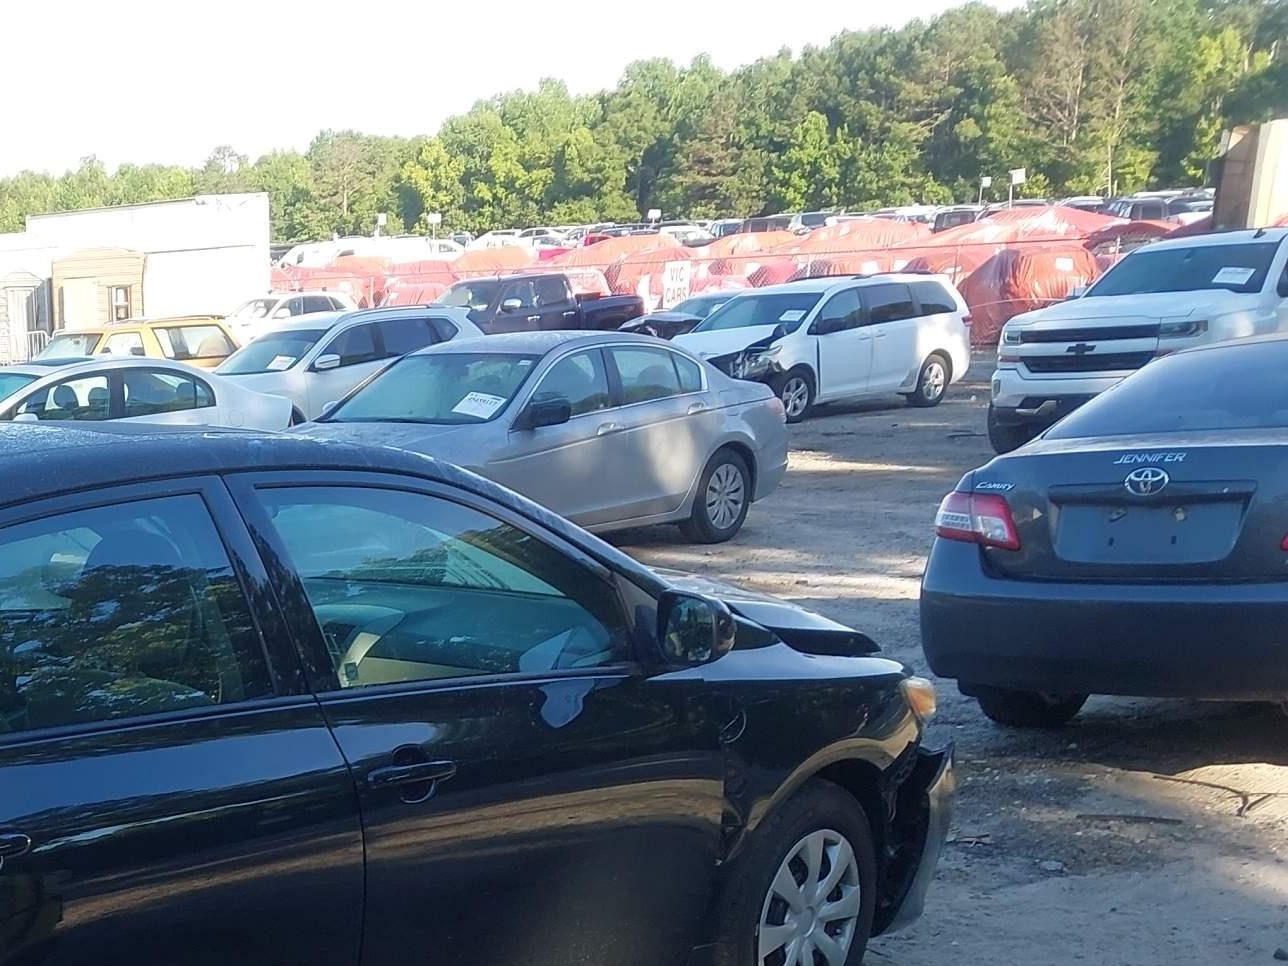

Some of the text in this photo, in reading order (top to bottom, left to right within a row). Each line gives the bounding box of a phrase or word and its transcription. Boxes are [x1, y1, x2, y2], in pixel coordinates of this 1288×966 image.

[670, 266, 684, 282] VIC
[665, 287, 687, 303] CARS
[1112, 452, 1187, 465] JENNIFER
